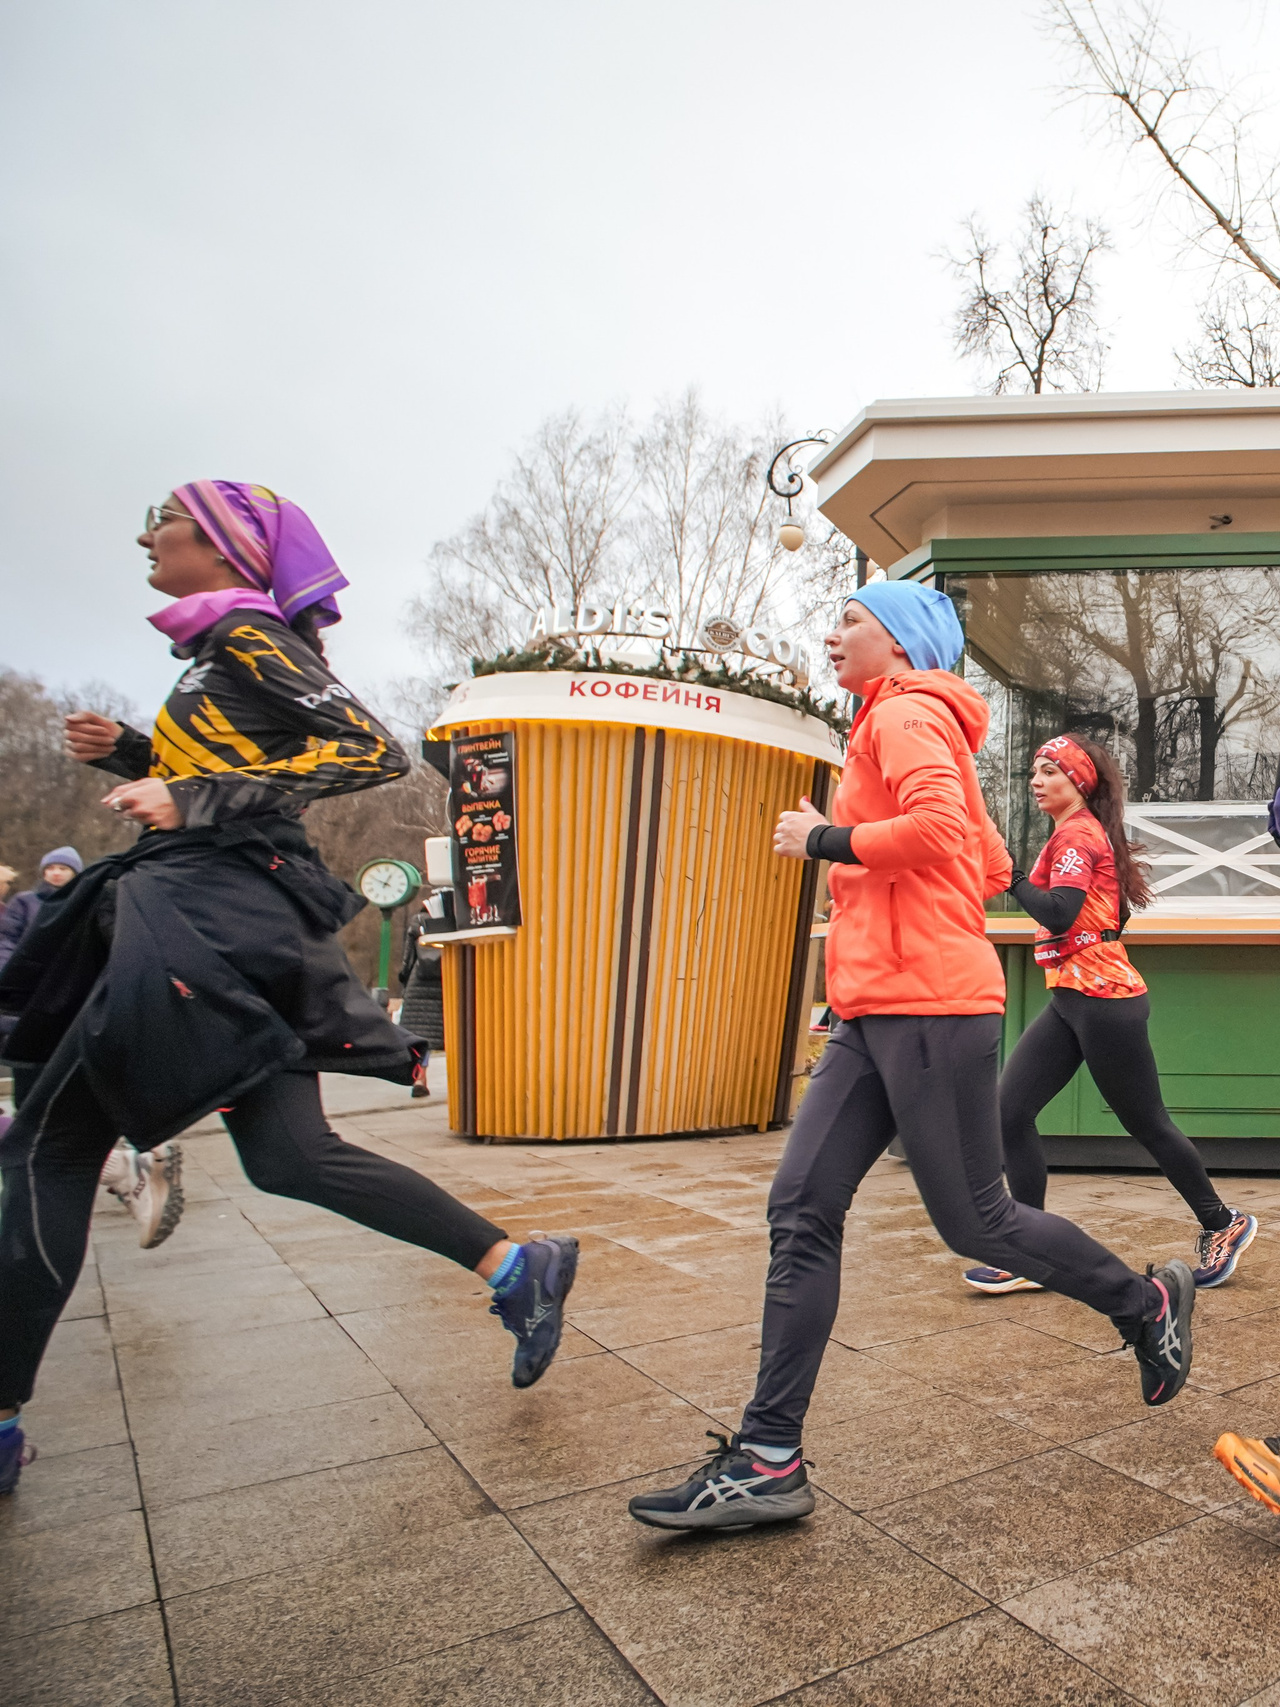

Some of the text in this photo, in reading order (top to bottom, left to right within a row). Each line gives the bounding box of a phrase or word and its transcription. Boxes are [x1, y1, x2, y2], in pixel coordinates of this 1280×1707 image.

[526, 602, 672, 640] ALDI'S
[568, 680, 722, 714] КОФЕЙНЯ
[457, 739, 502, 754] ГЛИНТВЕЙН
[461, 800, 501, 813] ВЫПЕЧКА
[464, 844, 501, 857] ГОРЯЧИЕ
